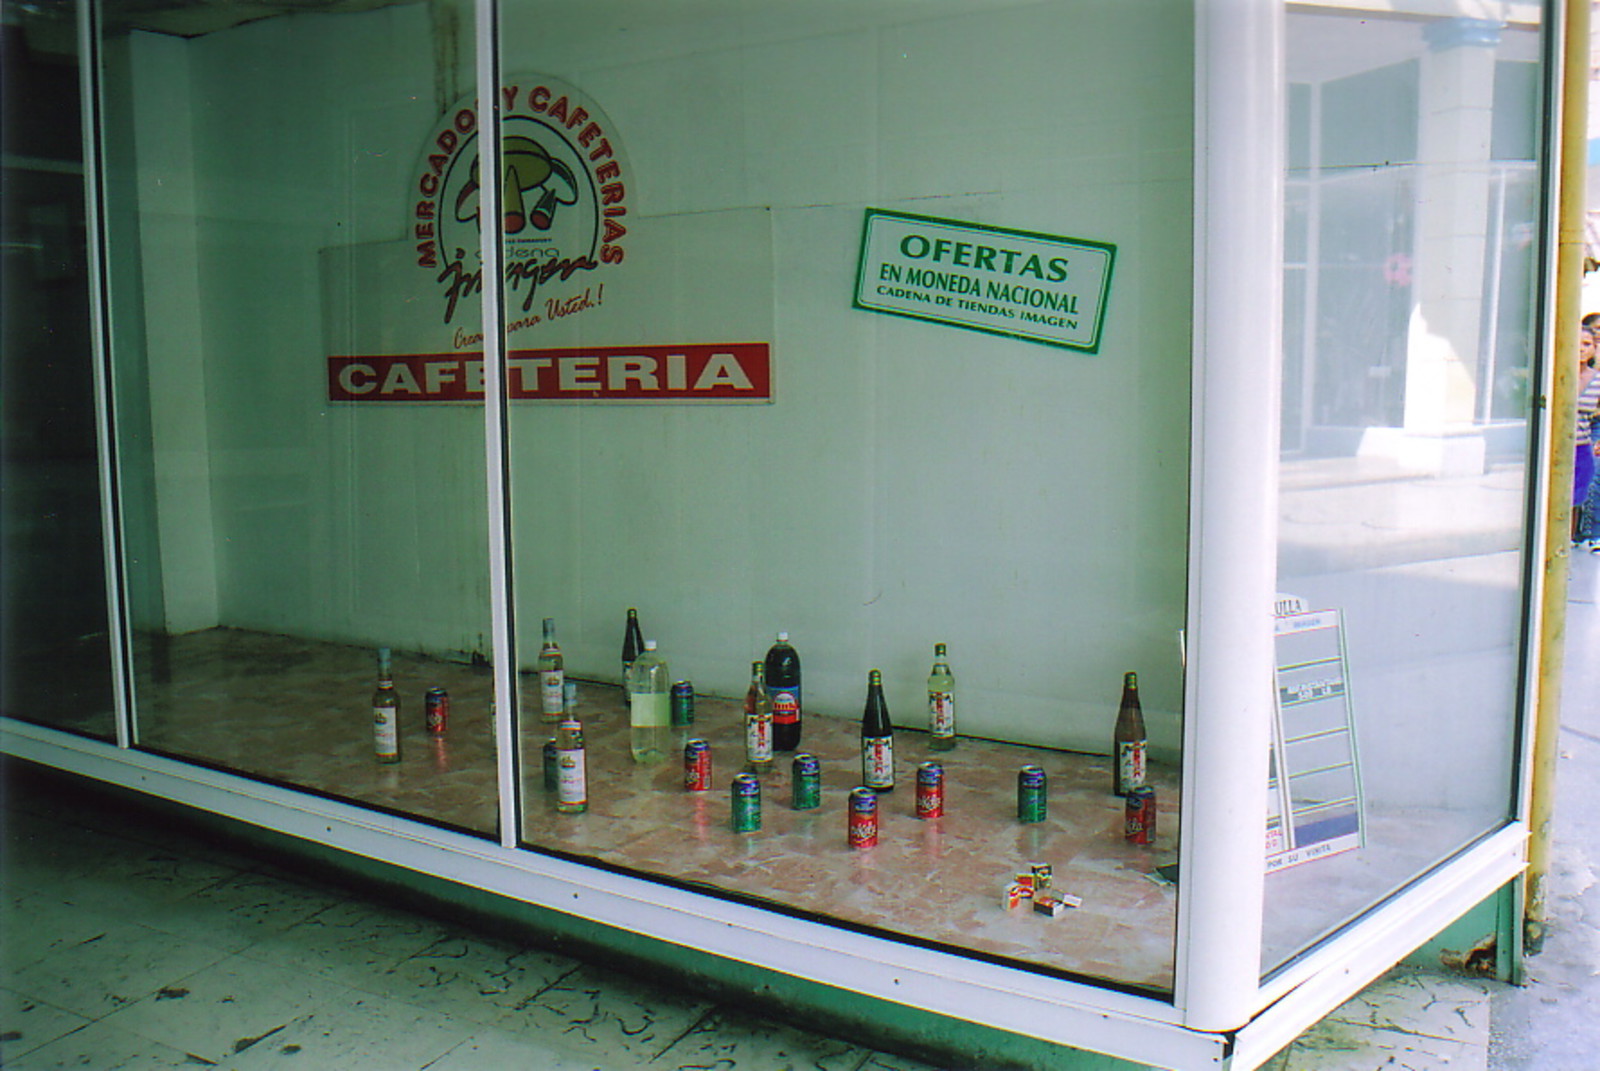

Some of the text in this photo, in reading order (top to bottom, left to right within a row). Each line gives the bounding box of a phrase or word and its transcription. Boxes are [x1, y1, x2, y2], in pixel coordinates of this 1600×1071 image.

[415, 85, 626, 269] MERCADO Y CAFETERIAS
[899, 235, 1069, 282] OFERTAS
[876, 285, 1078, 330] CADENA DE TIENDAS IMAGEN
[880, 262, 1079, 315] EN MONEDA NACIONAL
[338, 353, 756, 394] CAFETERIA
